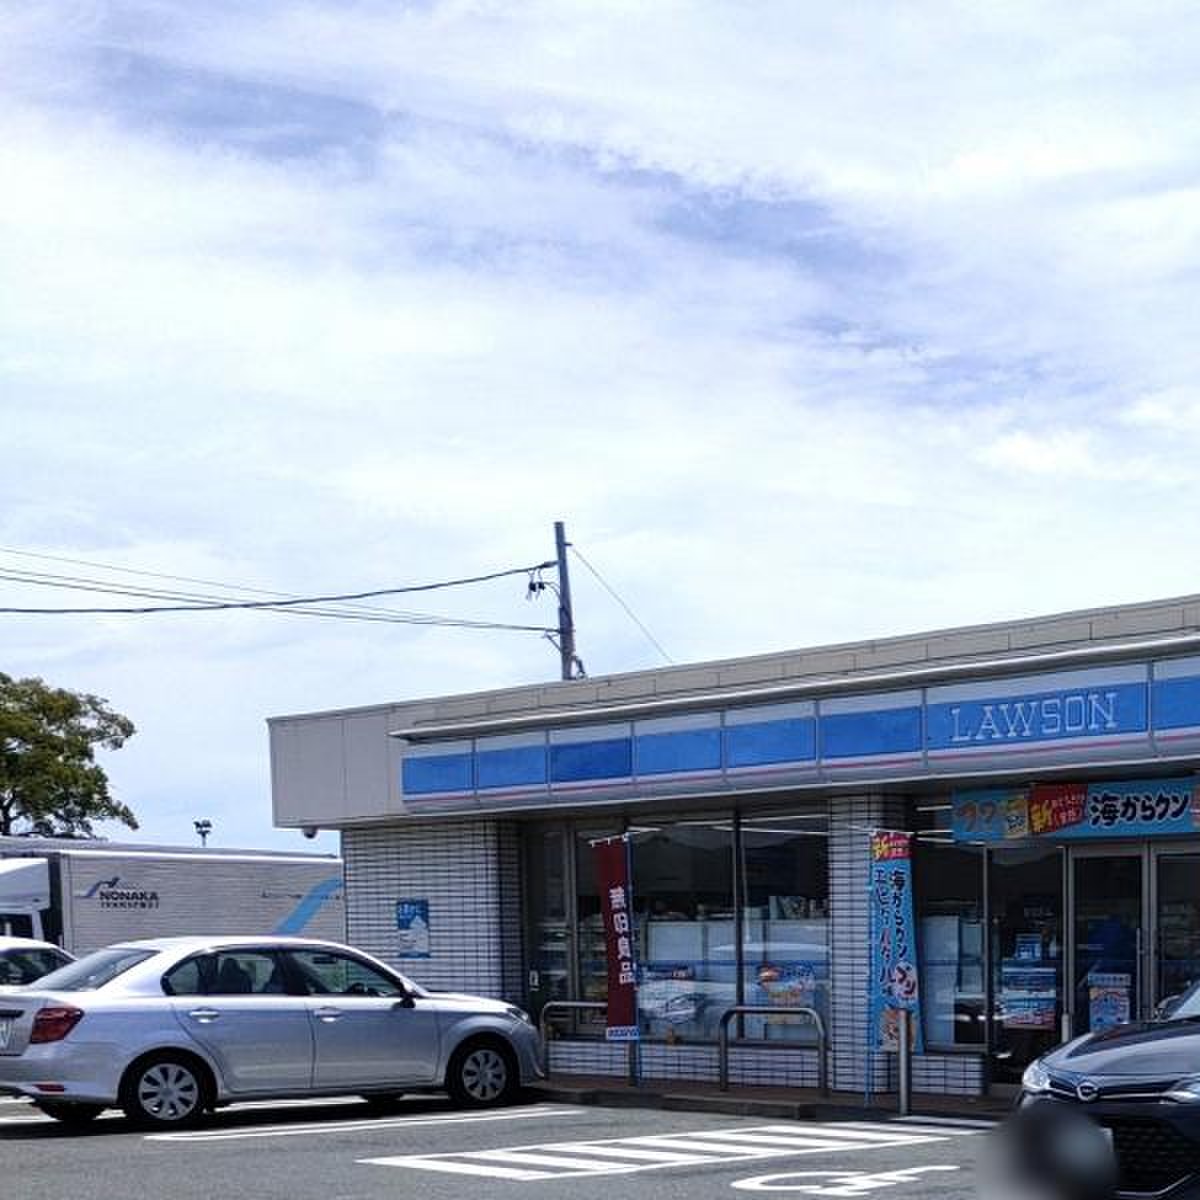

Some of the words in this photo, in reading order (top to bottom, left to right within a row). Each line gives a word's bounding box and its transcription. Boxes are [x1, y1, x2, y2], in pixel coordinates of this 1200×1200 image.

[951, 693, 1118, 742] LAWSON
[1090, 793, 1190, 827] 海からクン
[99, 891, 159, 901] NONAKA
